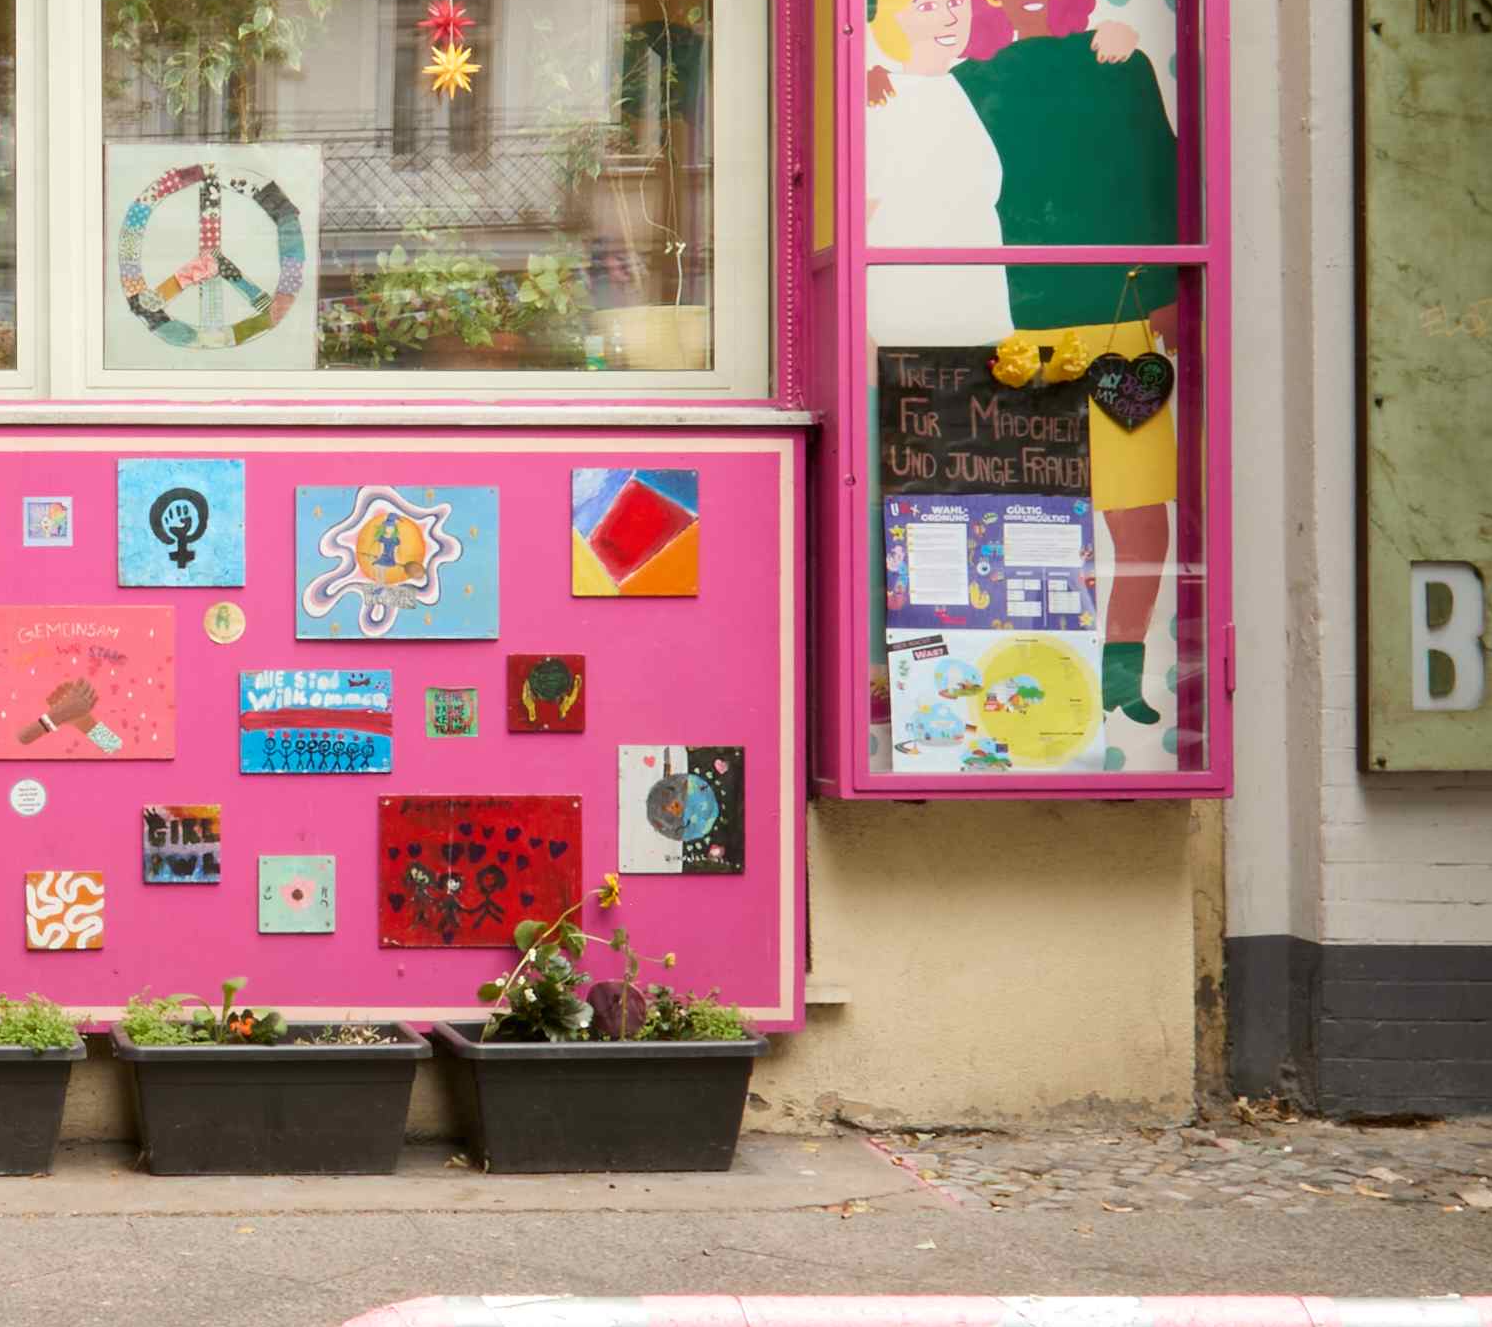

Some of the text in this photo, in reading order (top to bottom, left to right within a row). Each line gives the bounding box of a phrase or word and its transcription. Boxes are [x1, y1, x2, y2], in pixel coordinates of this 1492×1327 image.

[889, 444, 938, 479] UND
[1005, 505, 1043, 515] GÜLTIG
[17, 622, 120, 643] GEMEINSAM
